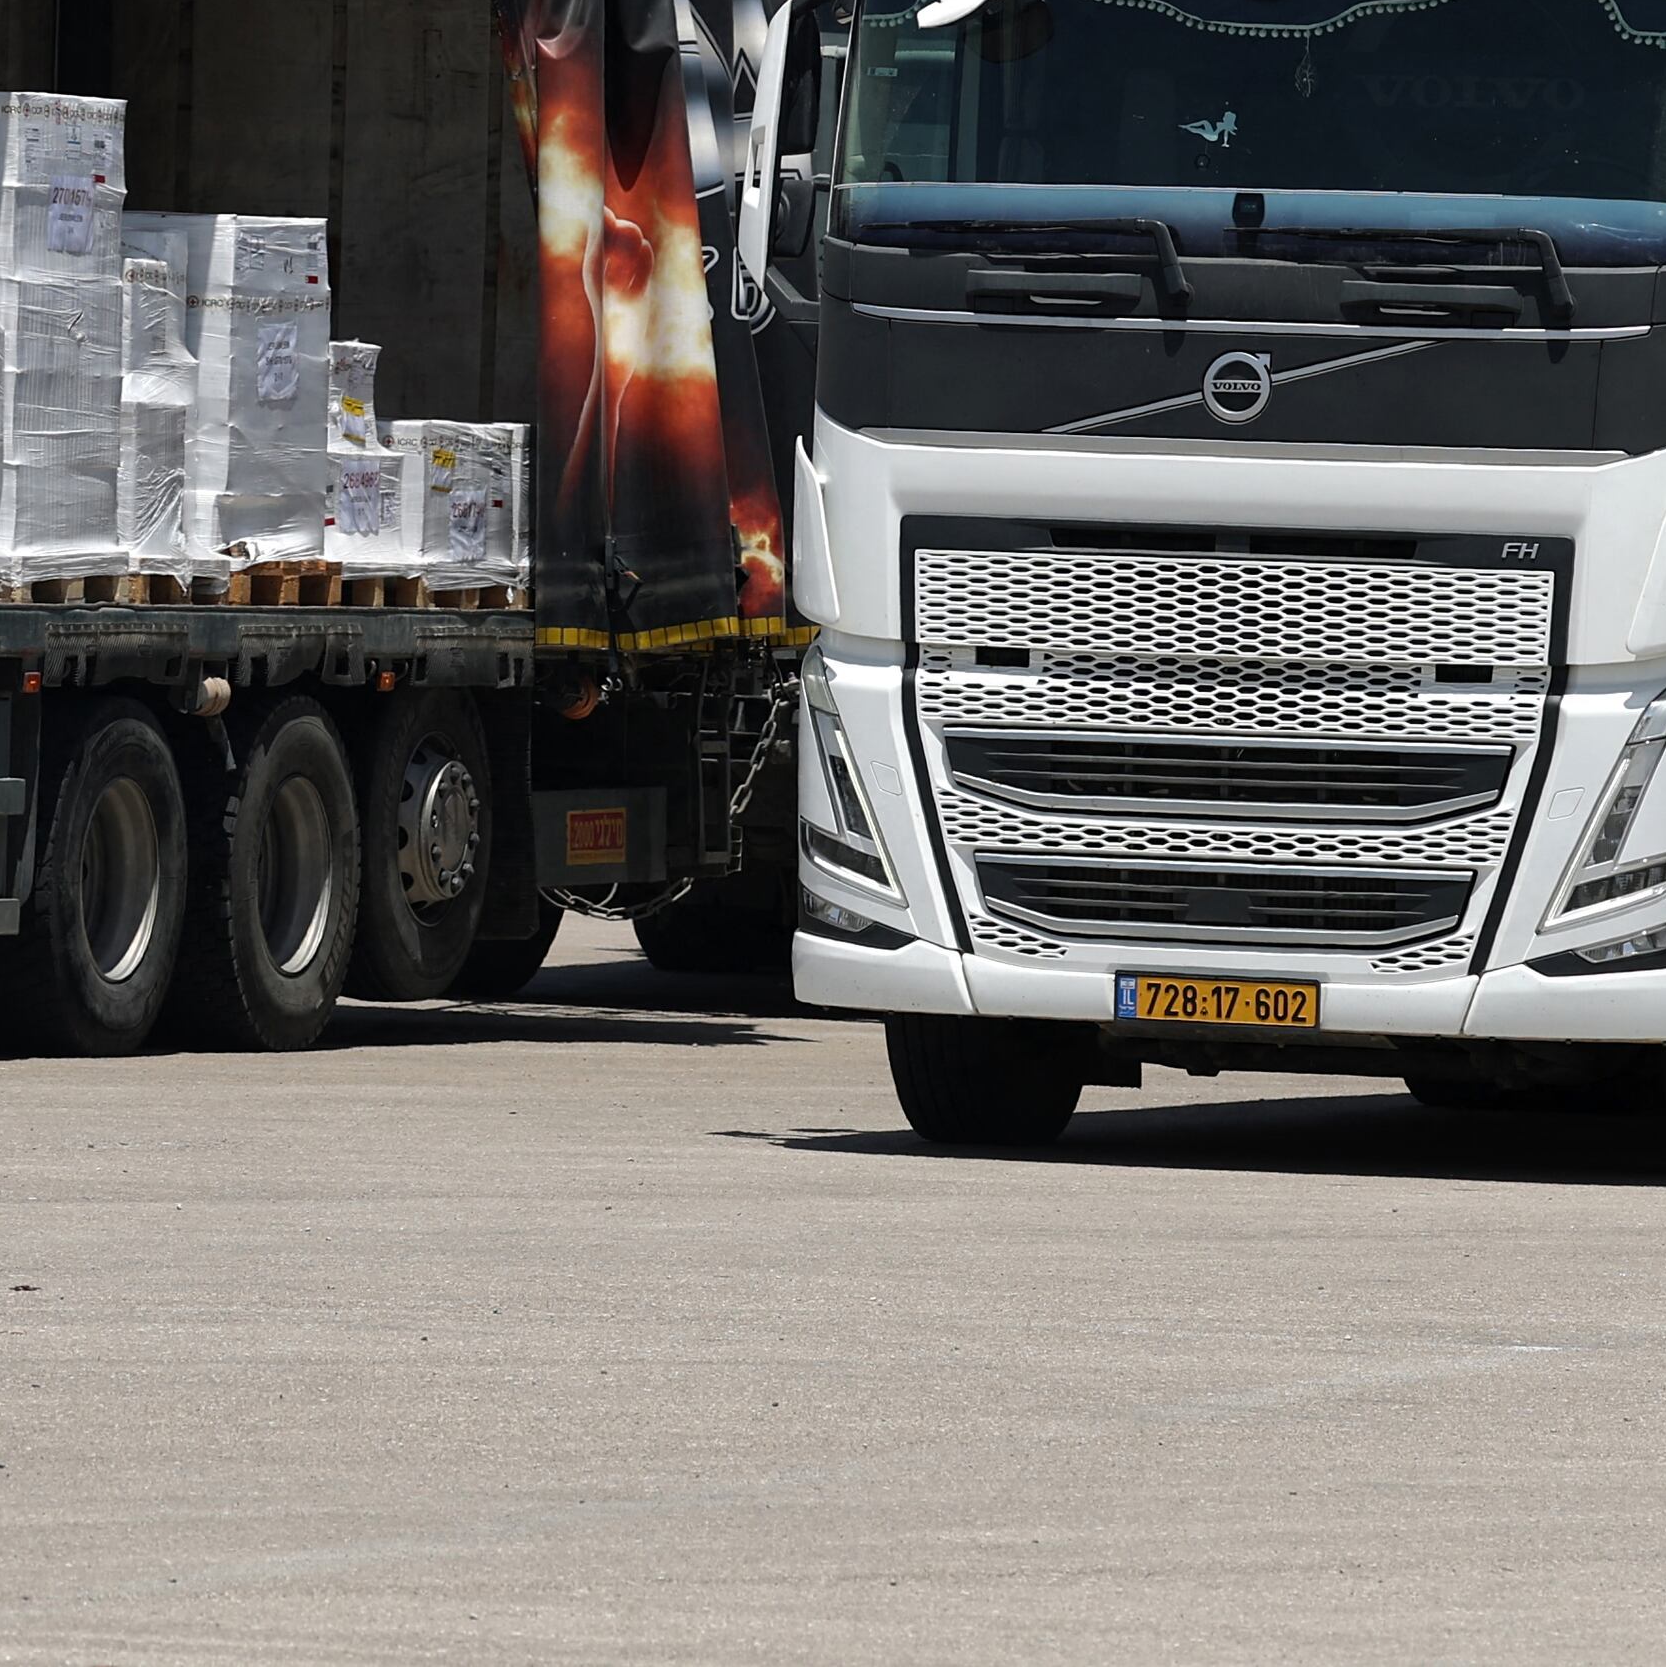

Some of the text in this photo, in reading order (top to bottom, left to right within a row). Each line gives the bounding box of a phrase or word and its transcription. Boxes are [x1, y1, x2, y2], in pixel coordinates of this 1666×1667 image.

[1213, 382, 1261, 391] VOLVO
[1501, 542, 1540, 559] FH
[1122, 988, 1134, 1005] IL
